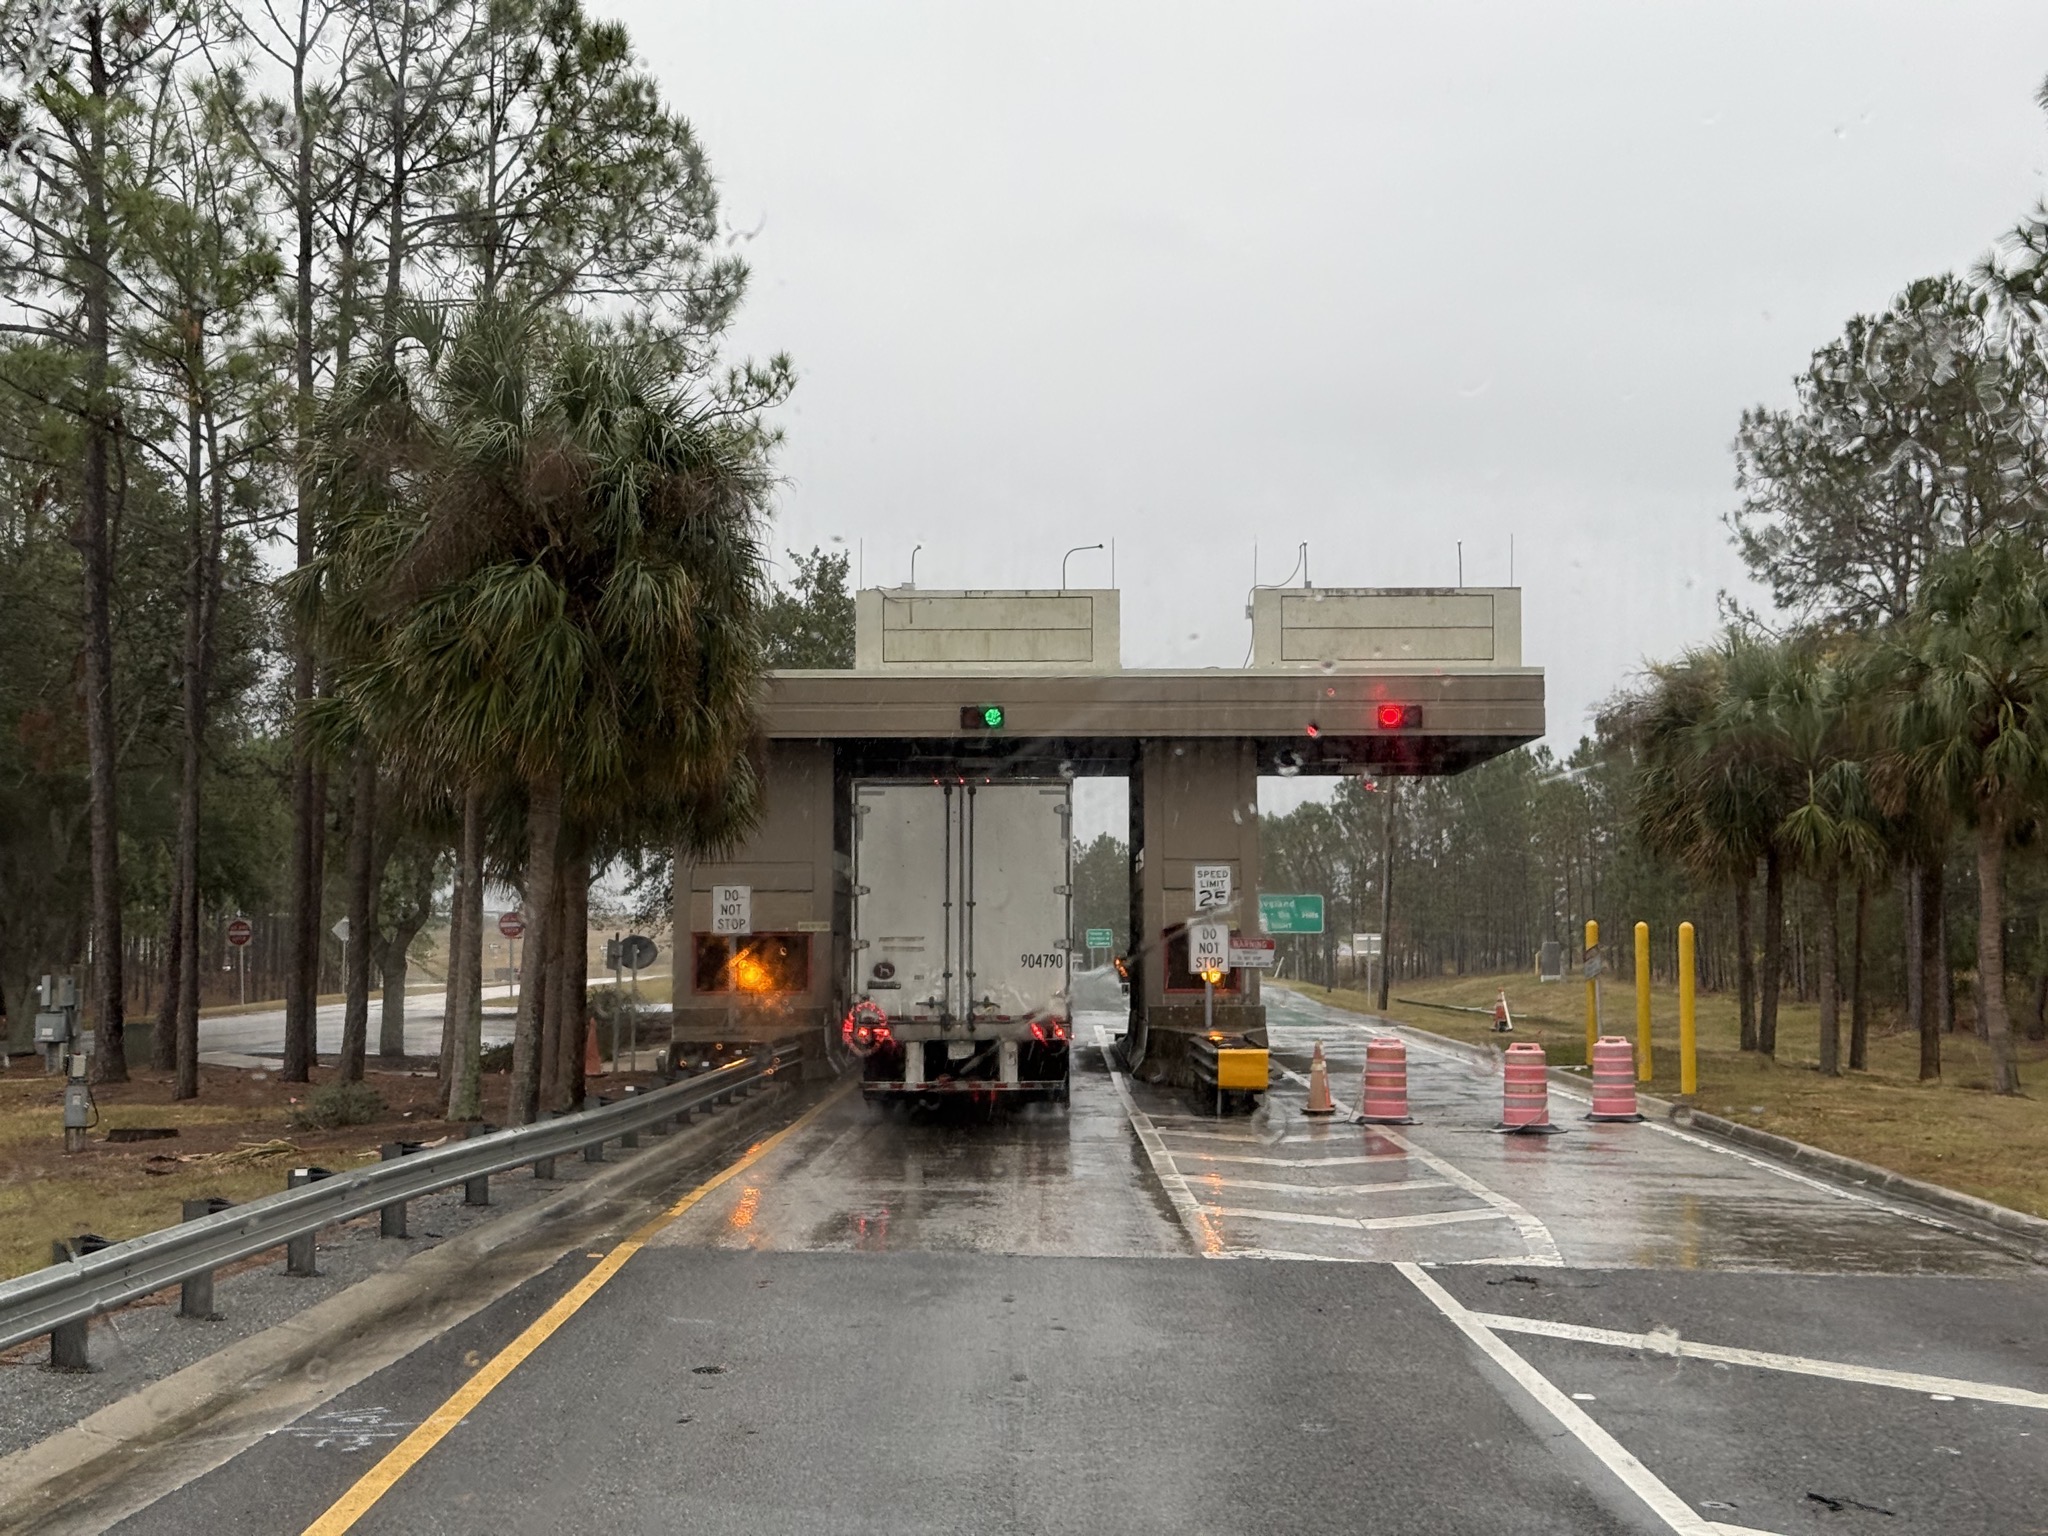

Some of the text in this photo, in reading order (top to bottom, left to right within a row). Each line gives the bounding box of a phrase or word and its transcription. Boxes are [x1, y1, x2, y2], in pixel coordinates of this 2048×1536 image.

[1197, 870, 1229, 878] SPEED
[1200, 880, 1225, 888] LIMIT
[724, 889, 739, 901] DO
[1199, 890, 1226, 907] 25
[720, 904, 742, 915] NOT
[717, 918, 746, 930] STOP
[1202, 928, 1217, 940] DO
[1199, 942, 1220, 954] NOT
[1232, 939, 1268, 949] WARNING
[1021, 953, 1063, 970] 904790
[1196, 956, 1224, 968] STOP
